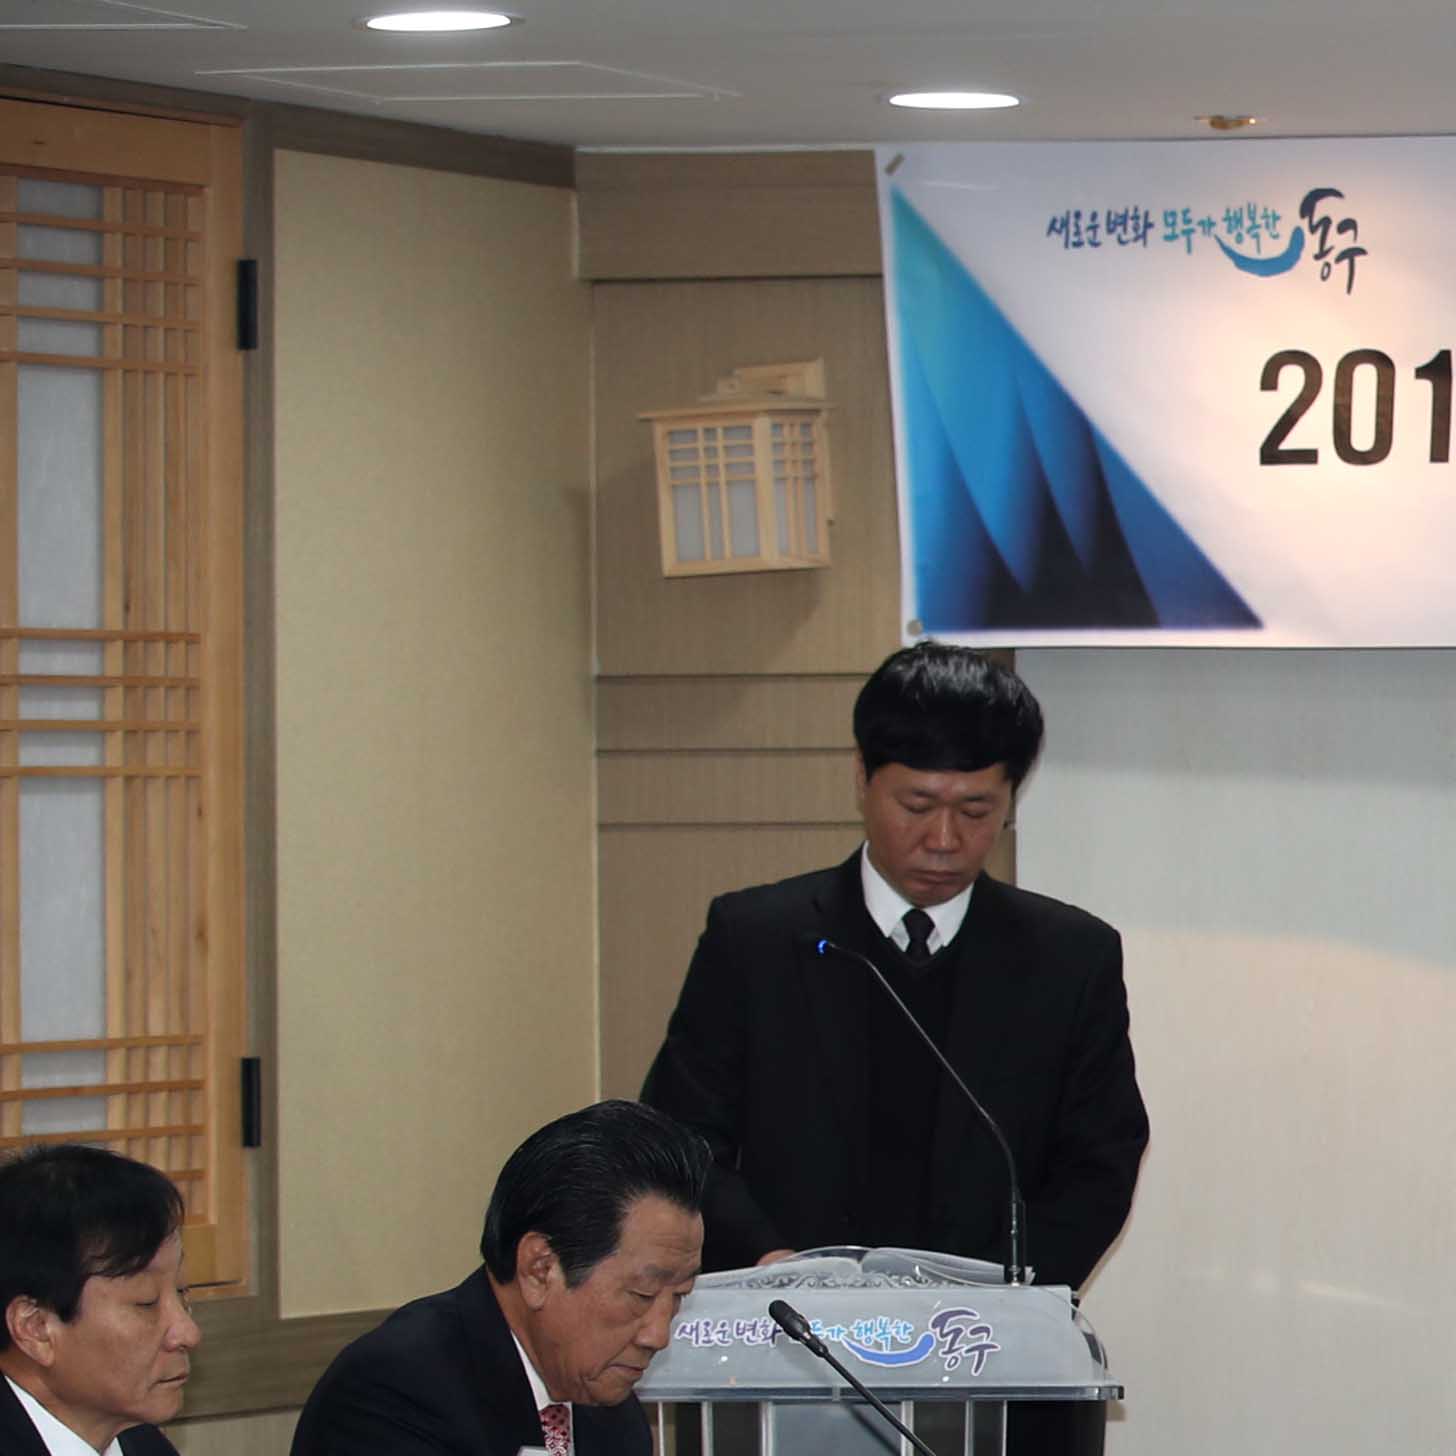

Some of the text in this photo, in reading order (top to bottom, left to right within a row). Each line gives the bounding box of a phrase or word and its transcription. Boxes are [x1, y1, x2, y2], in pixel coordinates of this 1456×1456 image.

[1047, 188, 1368, 294] 새로운 변화 모두가 행복한 동구
[676, 1318, 732, 1346] 새로운
[735, 1318, 782, 1347] 변화
[853, 1317, 913, 1352] 행복한
[930, 1306, 1001, 1376] 동구
